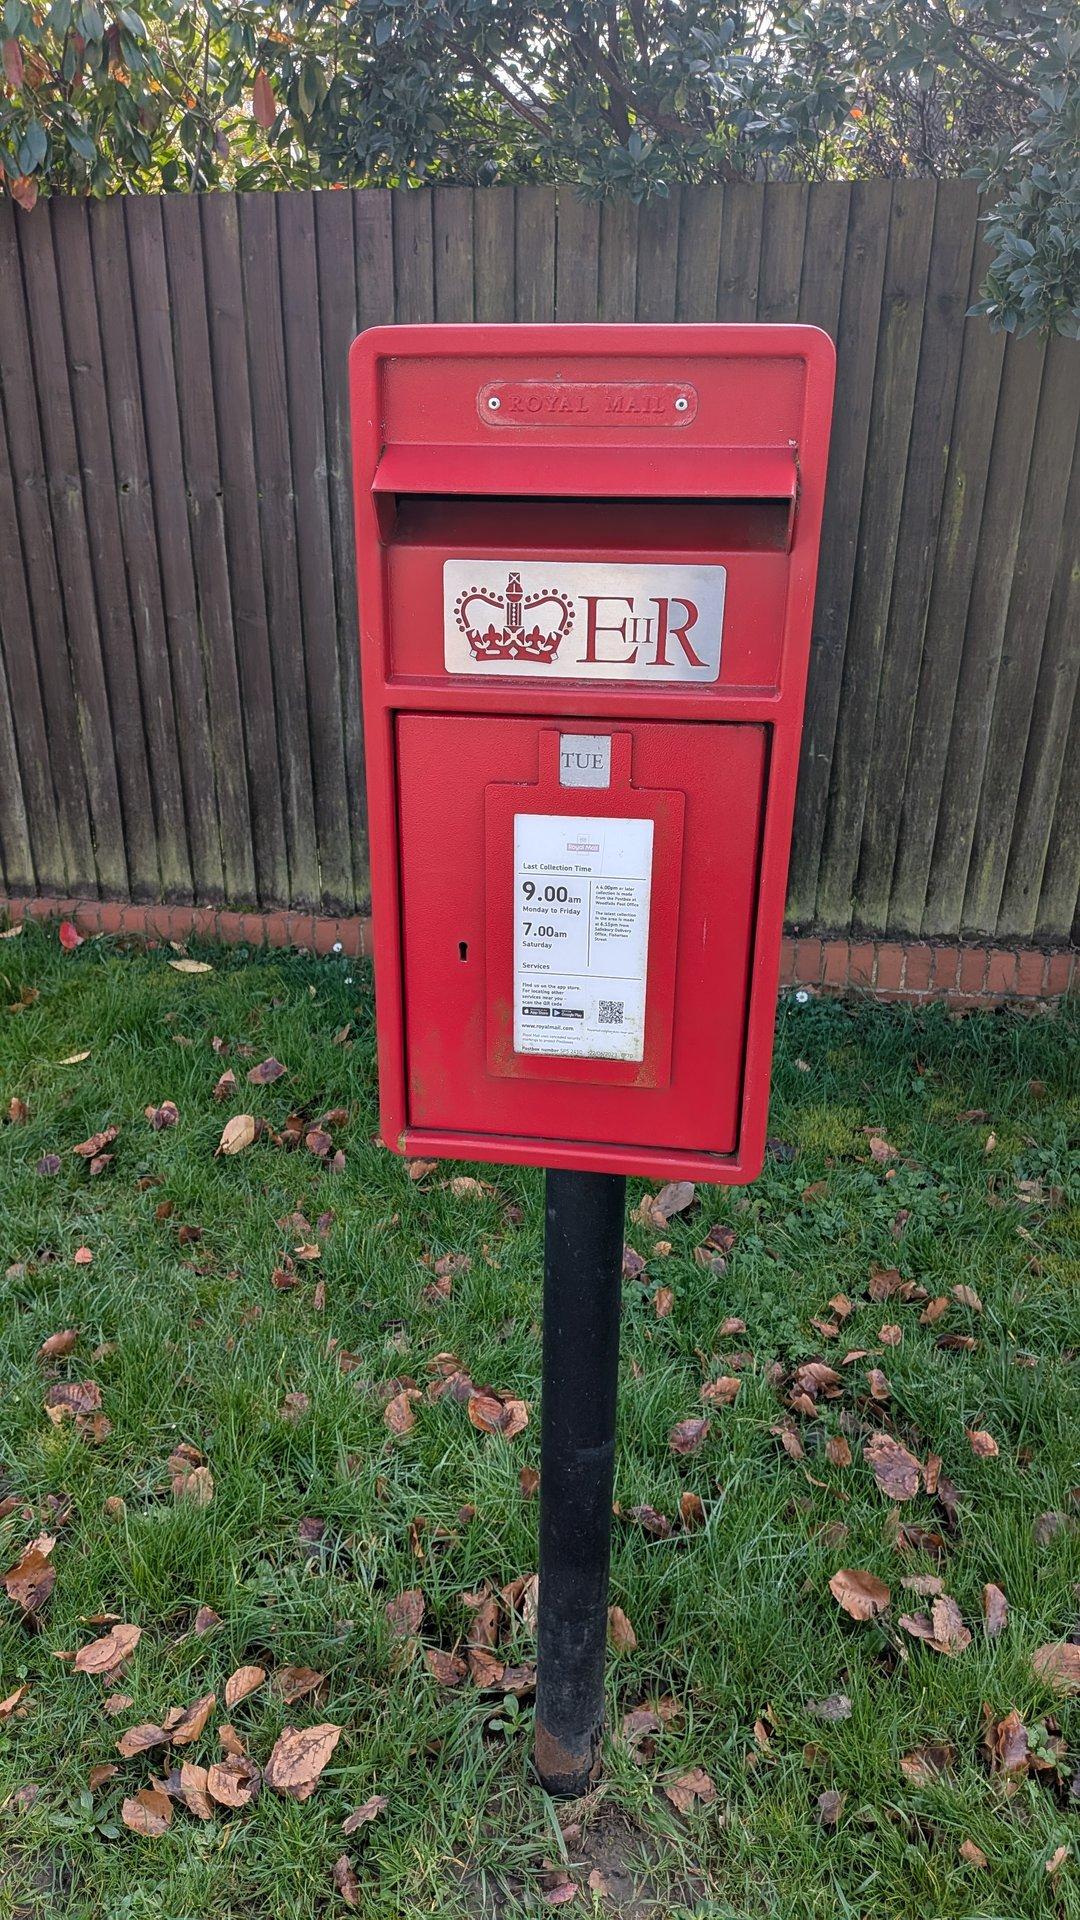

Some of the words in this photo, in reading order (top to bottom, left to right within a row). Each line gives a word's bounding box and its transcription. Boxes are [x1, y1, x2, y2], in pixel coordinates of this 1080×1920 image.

[508, 395, 590, 414] ROYAL
[605, 396, 667, 414] MAIL
[561, 752, 604, 769] TUE
[523, 862, 538, 870] Last
[540, 863, 573, 872] Collection
[574, 865, 592, 873] Time
[522, 881, 581, 904] 9.00am
[522, 906, 548, 914] Monday
[560, 908, 581, 916] Friday
[522, 922, 567, 938] 7.00am
[522, 941, 553, 949] Saturday
[522, 962, 550, 970] Services
[522, 1023, 574, 1031] www.royalmail.com
